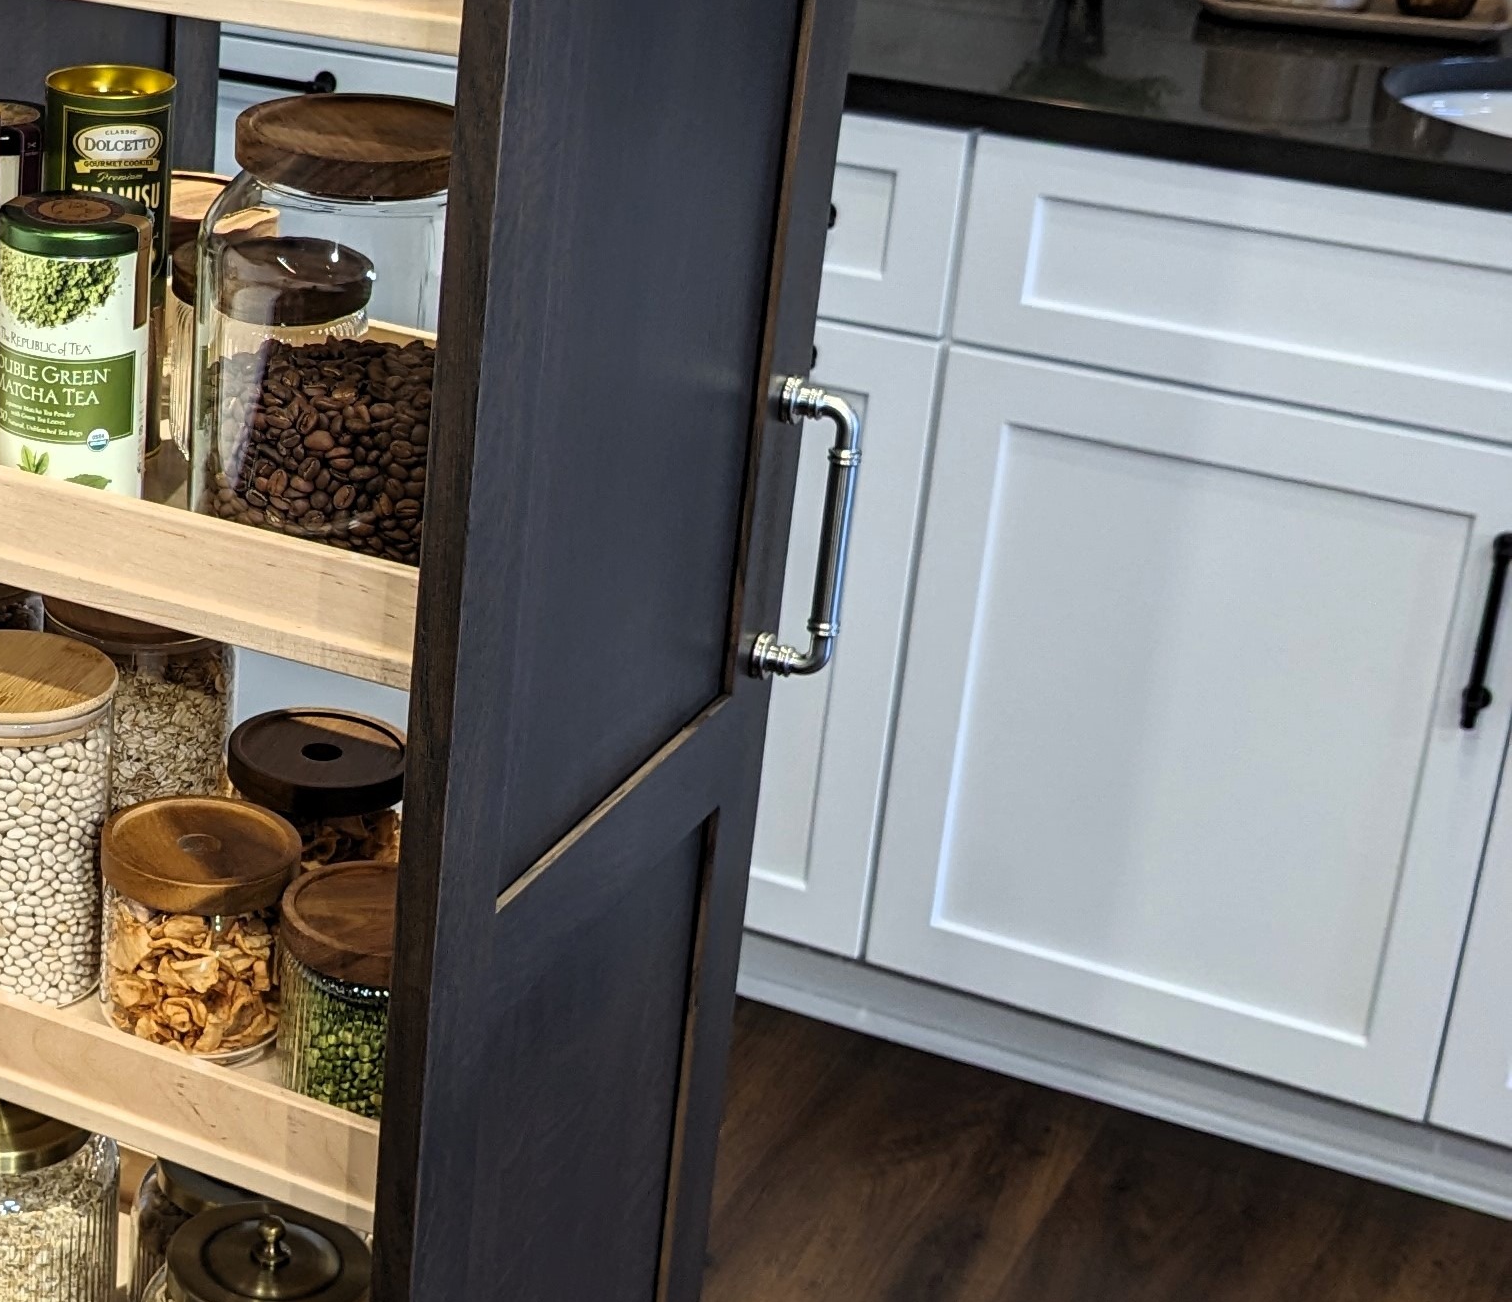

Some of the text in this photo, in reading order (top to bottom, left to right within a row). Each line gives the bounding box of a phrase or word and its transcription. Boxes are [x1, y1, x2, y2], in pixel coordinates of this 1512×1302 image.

[84, 137, 156, 152] DOLCETTO
[123, 159, 154, 167] COOKIES
[96, 171, 143, 183] Premium
[10, 331, 57, 354] REPUBLIC
[57, 342, 67, 356] of
[68, 342, 91, 355] TEA
[41, 365, 108, 386] GREEN
[62, 388, 100, 406] TEA
[0, 407, 8, 422] 50
